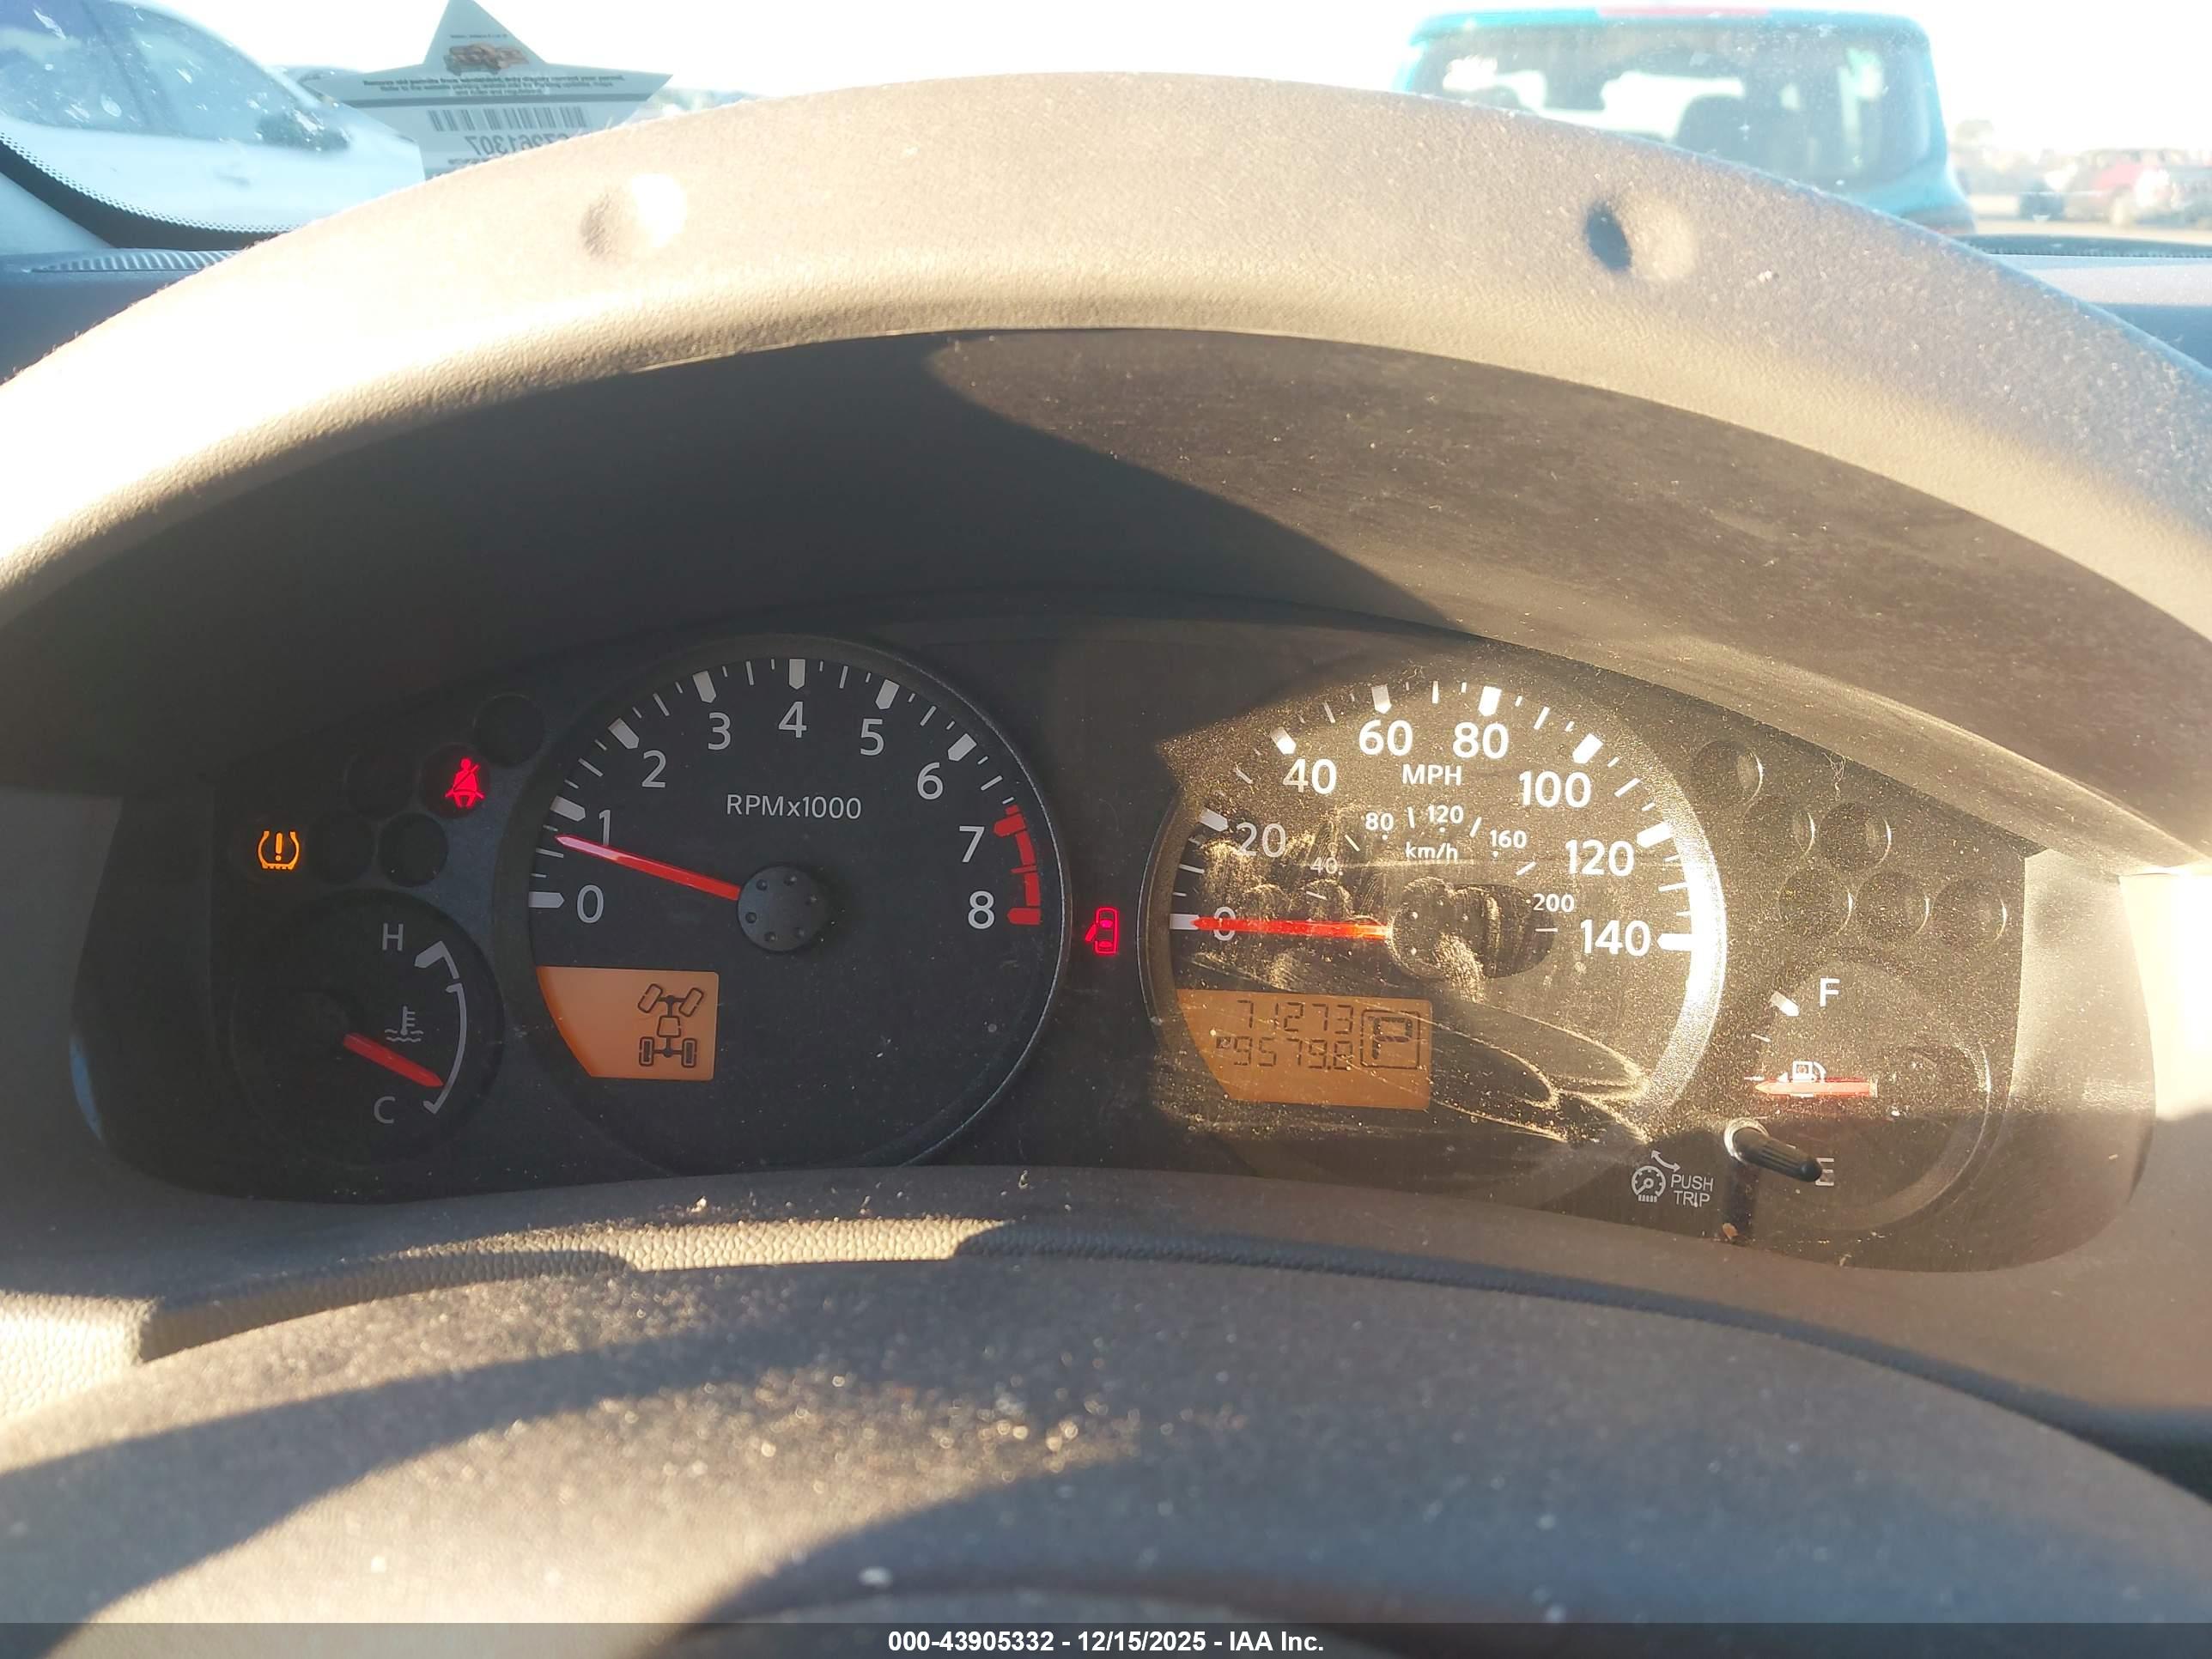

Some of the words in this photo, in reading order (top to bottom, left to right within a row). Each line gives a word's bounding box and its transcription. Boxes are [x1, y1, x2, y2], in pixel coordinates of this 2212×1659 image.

[708, 713, 731, 750] 3
[778, 702, 807, 738] 4
[860, 719, 884, 756] 5
[1358, 720, 1413, 756] 60
[1452, 722, 1510, 759] 80
[642, 750, 666, 788] 2
[917, 762, 944, 800] 6
[1282, 758, 1337, 795] 40
[1401, 764, 1462, 786] MPH
[726, 794, 862, 819] RPMx1000
[1519, 770, 1591, 808] 100
[599, 810, 611, 846] 1
[1364, 812, 1395, 832] 80
[1427, 805, 1464, 824] 120
[959, 826, 985, 863] 7
[1236, 823, 1286, 858] 20
[1405, 841, 1459, 860] km/h
[1490, 830, 1527, 849] 160
[1565, 839, 1634, 876] 120
[1310, 855, 1338, 875] 40
[576, 884, 604, 924] 0
[968, 890, 994, 930] 8
[1533, 893, 1575, 913] 200
[382, 923, 404, 951] H
[1213, 906, 1237, 941] 0
[1581, 919, 1650, 957] 140
[1820, 977, 1840, 1007] F
[1237, 999, 1354, 1035] 71273
[1367, 1016, 1413, 1060] P
[374, 1096, 396, 1124] C
[1670, 1173, 1714, 1192] PUSH
[1673, 1189, 1711, 1207] TRIP
